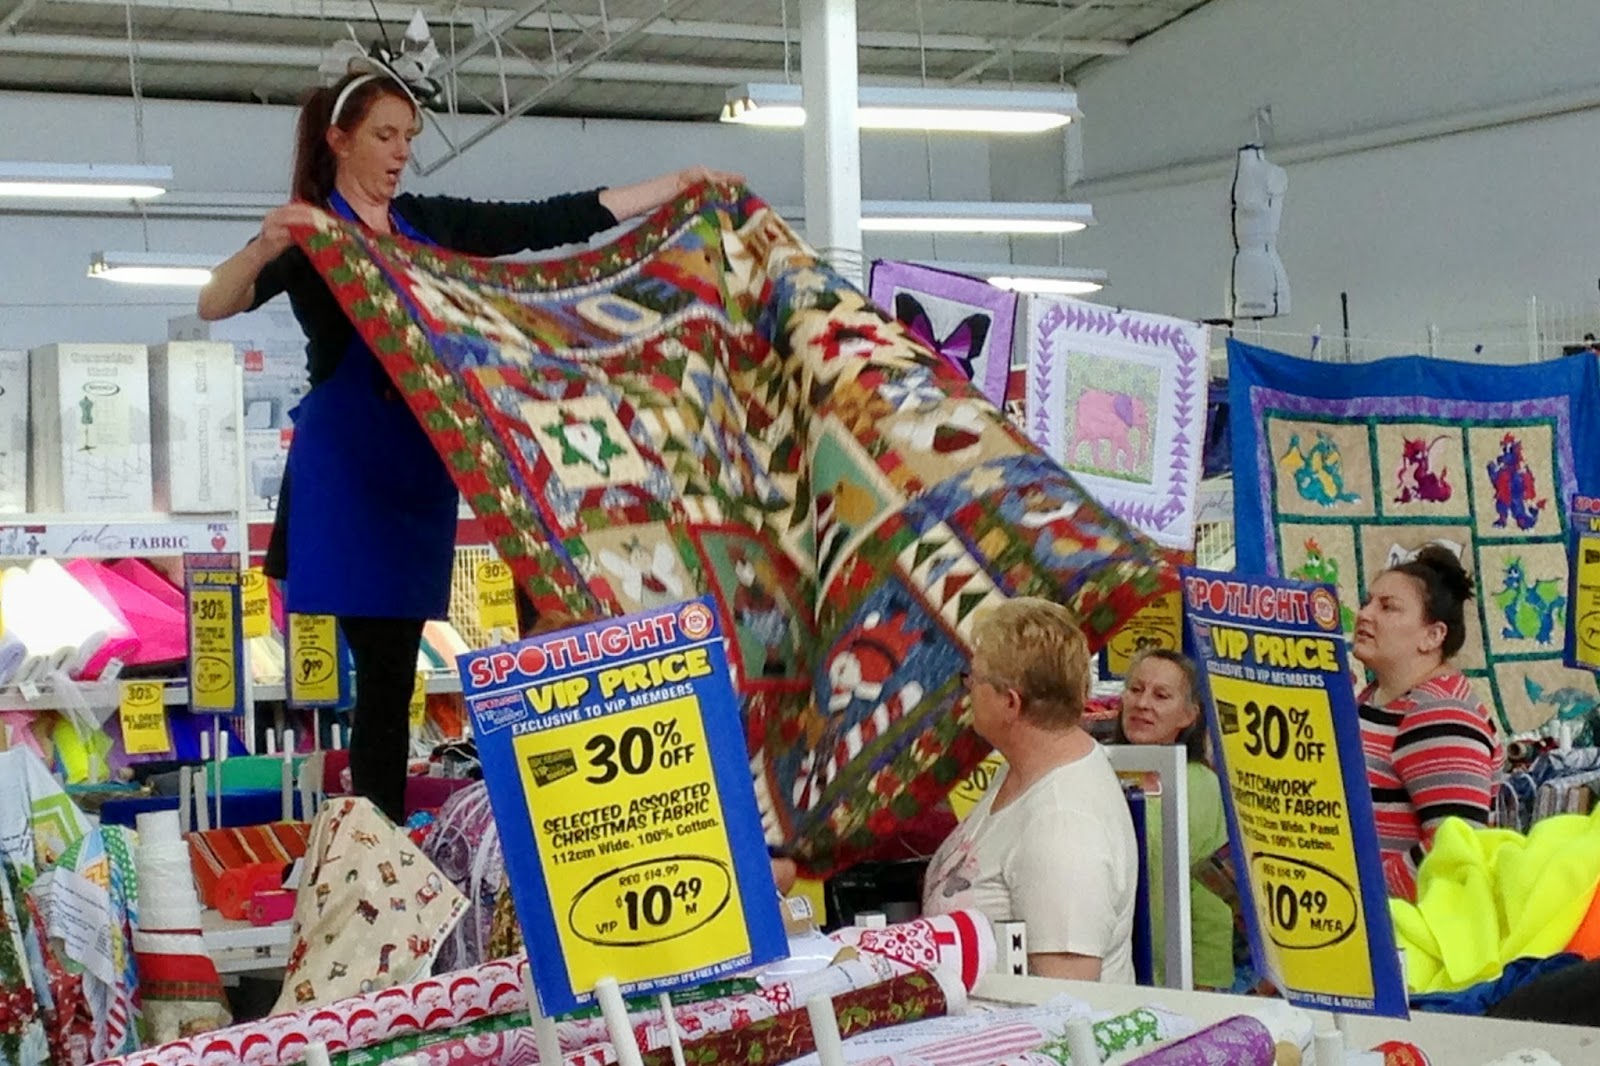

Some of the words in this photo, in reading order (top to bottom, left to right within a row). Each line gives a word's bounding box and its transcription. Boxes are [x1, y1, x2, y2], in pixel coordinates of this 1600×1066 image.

[130, 536, 190, 549] FABRIC
[1185, 576, 1309, 624] SPOTLIGHT
[468, 613, 676, 688] SPOTLIGHT
[1211, 627, 1249, 660] VIP
[1254, 633, 1339, 672] PRICE
[525, 676, 590, 714] VIP
[598, 648, 712, 699] PRICE
[1271, 671, 1325, 688] MEMBERS
[512, 711, 581, 736] EXCLUSIVE
[584, 705, 602, 718] TO
[604, 698, 627, 713] VIP
[631, 683, 694, 709] MEMBERS
[660, 743, 696, 768] OFF
[1295, 741, 1326, 763] OFF
[542, 804, 622, 836] SELECTED
[629, 783, 711, 815] ASSORTED
[1285, 798, 1341, 818] FABRIC
[552, 815, 647, 848] CHRISTMAS
[652, 799, 710, 824] FABRIC
[1310, 822, 1340, 835] Panel
[552, 848, 596, 865] 112cm
[599, 840, 634, 857] Wide.
[638, 827, 673, 845] 100%
[677, 817, 719, 837] Cotton.
[1298, 838, 1335, 850] Cotton.
[644, 864, 680, 882] $14.99
[685, 903, 698, 916] M
[596, 921, 618, 934] VIP
